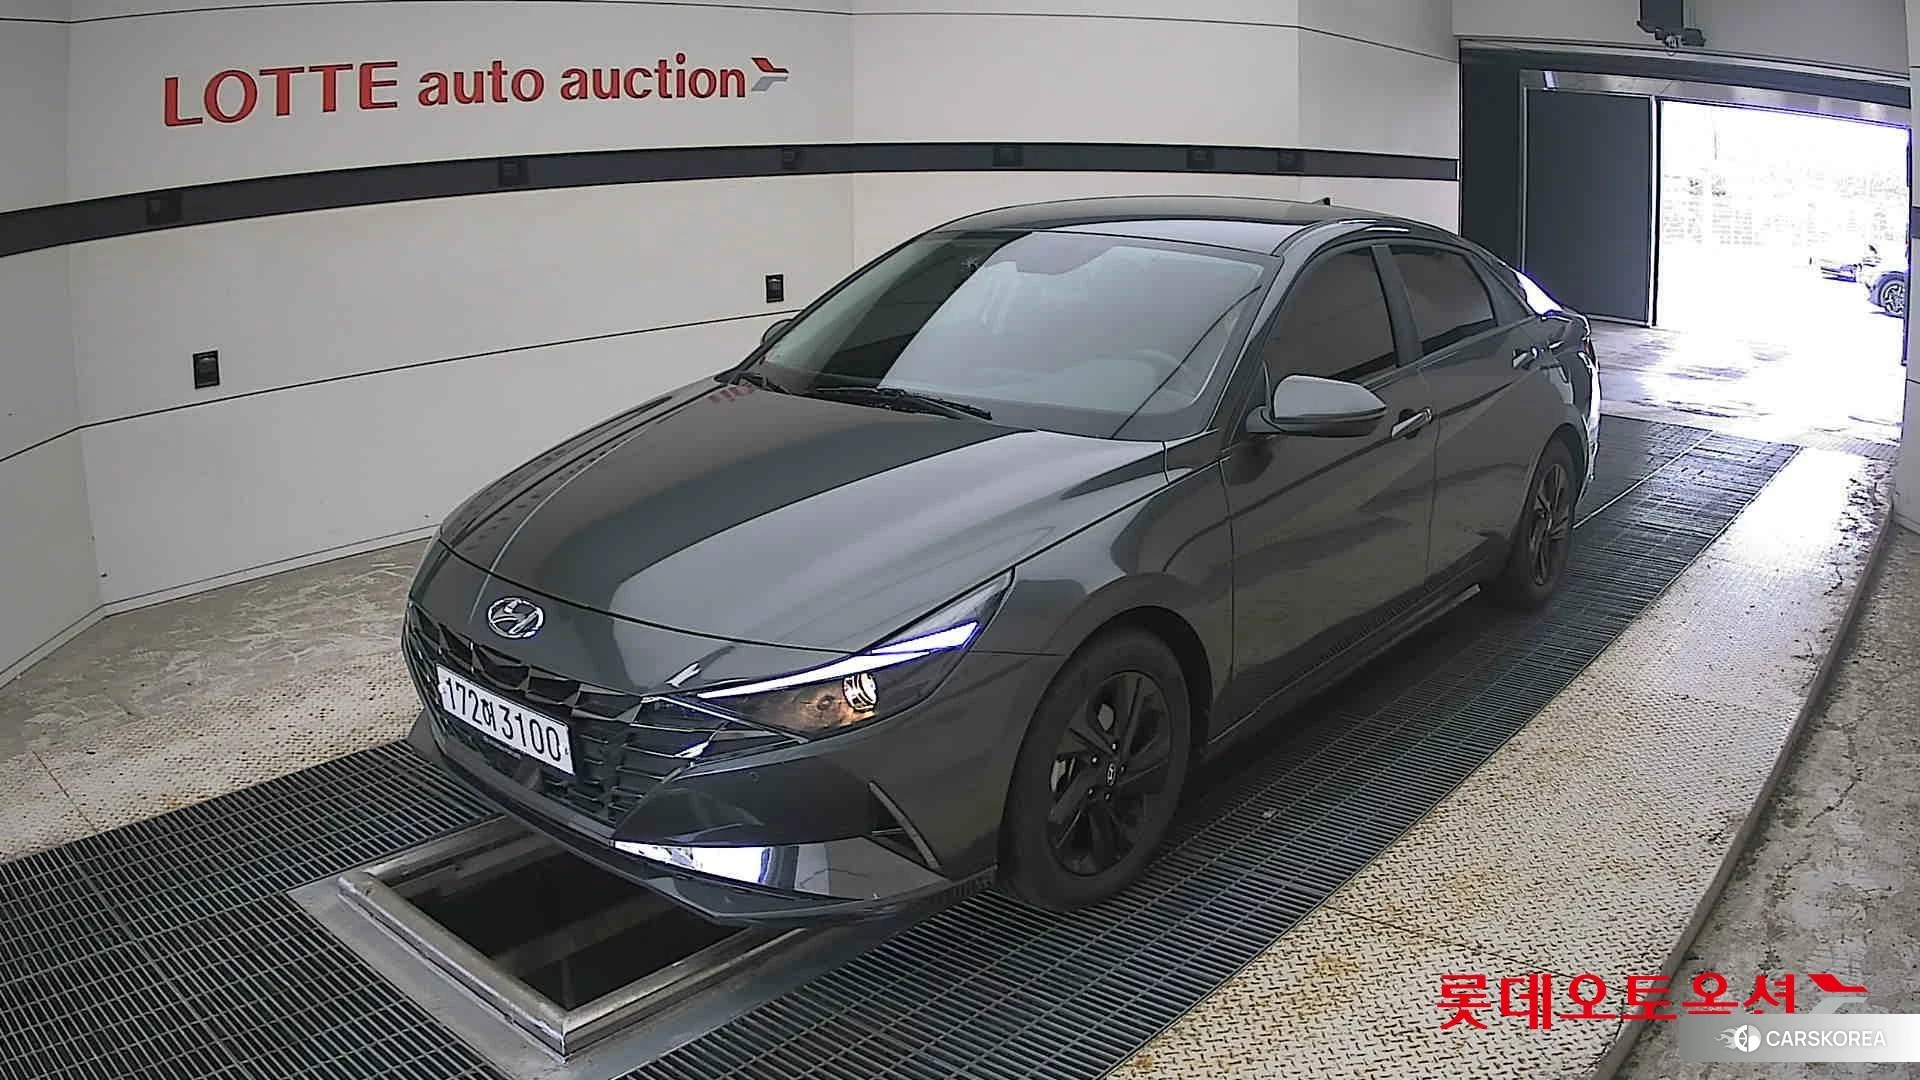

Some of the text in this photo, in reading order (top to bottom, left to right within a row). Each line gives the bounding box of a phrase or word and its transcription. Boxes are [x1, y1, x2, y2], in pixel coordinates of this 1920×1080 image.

[164, 53, 746, 127] LOTTE auto auction
